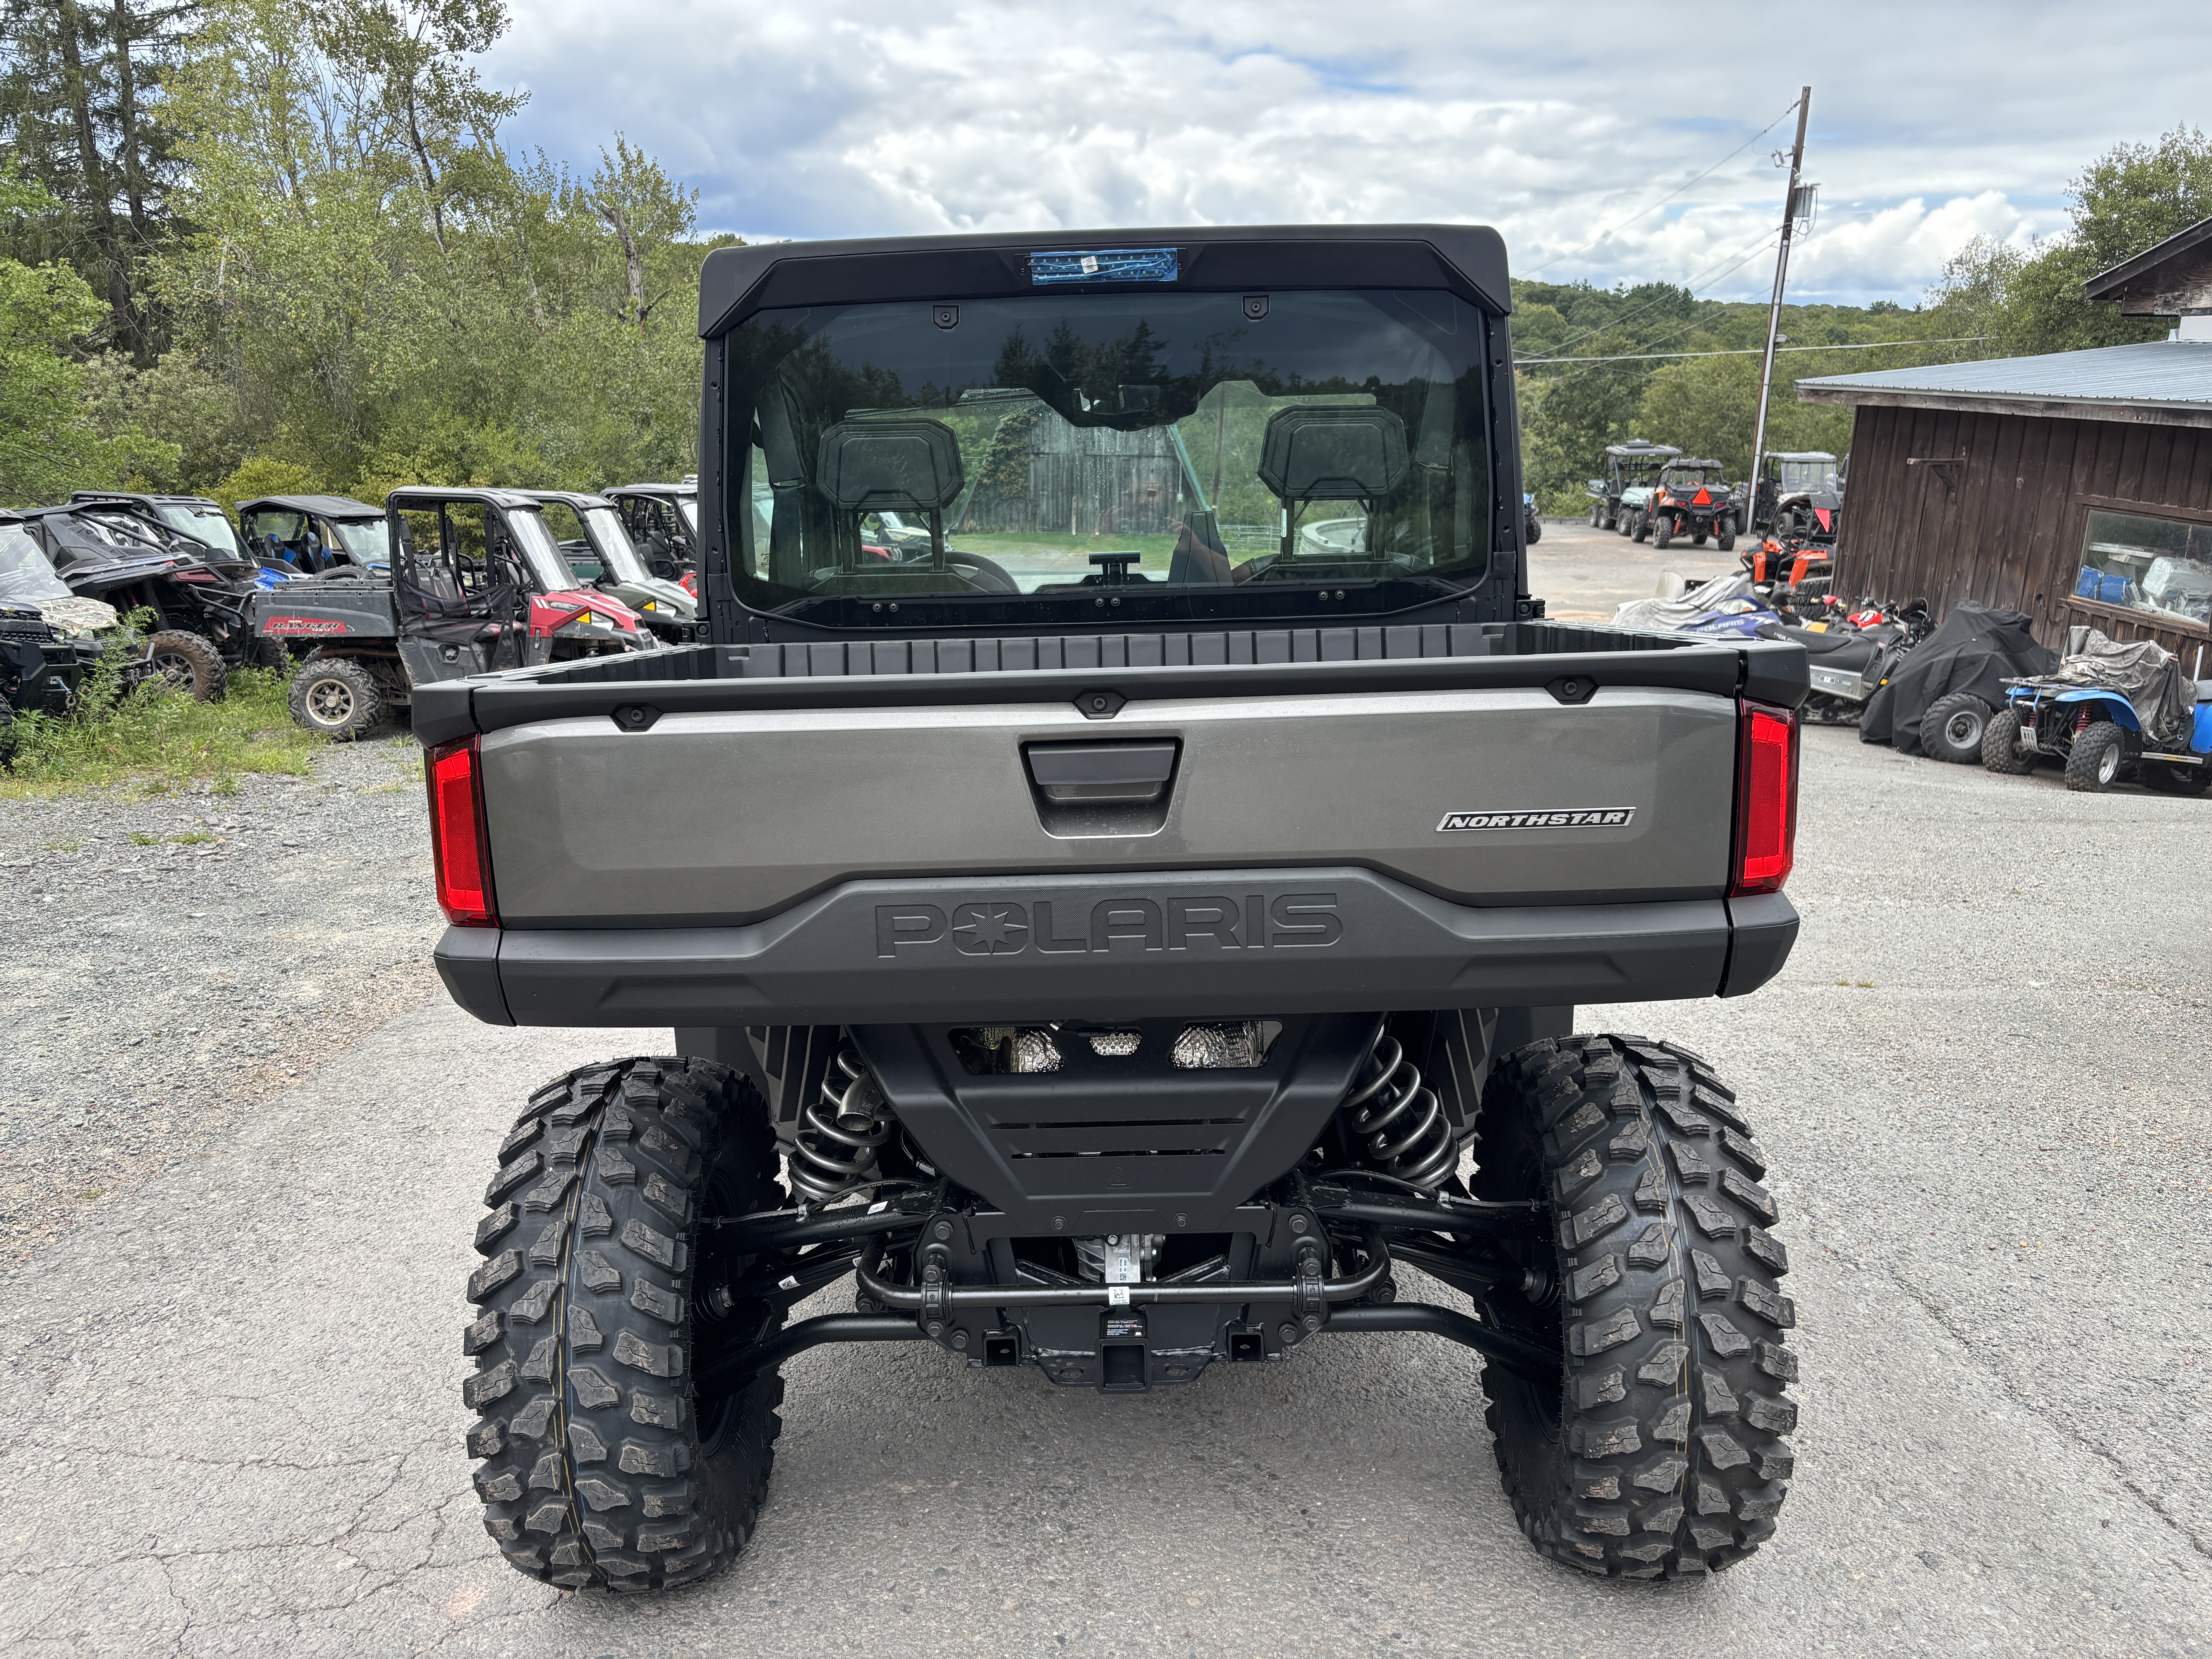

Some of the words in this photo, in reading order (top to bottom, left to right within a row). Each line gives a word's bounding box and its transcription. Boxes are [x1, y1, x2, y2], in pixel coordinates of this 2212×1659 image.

[1696, 619, 1745, 633] POLARIS
[1447, 812, 1626, 828] NORTHSTAR
[876, 893, 1344, 958] POLARIS
